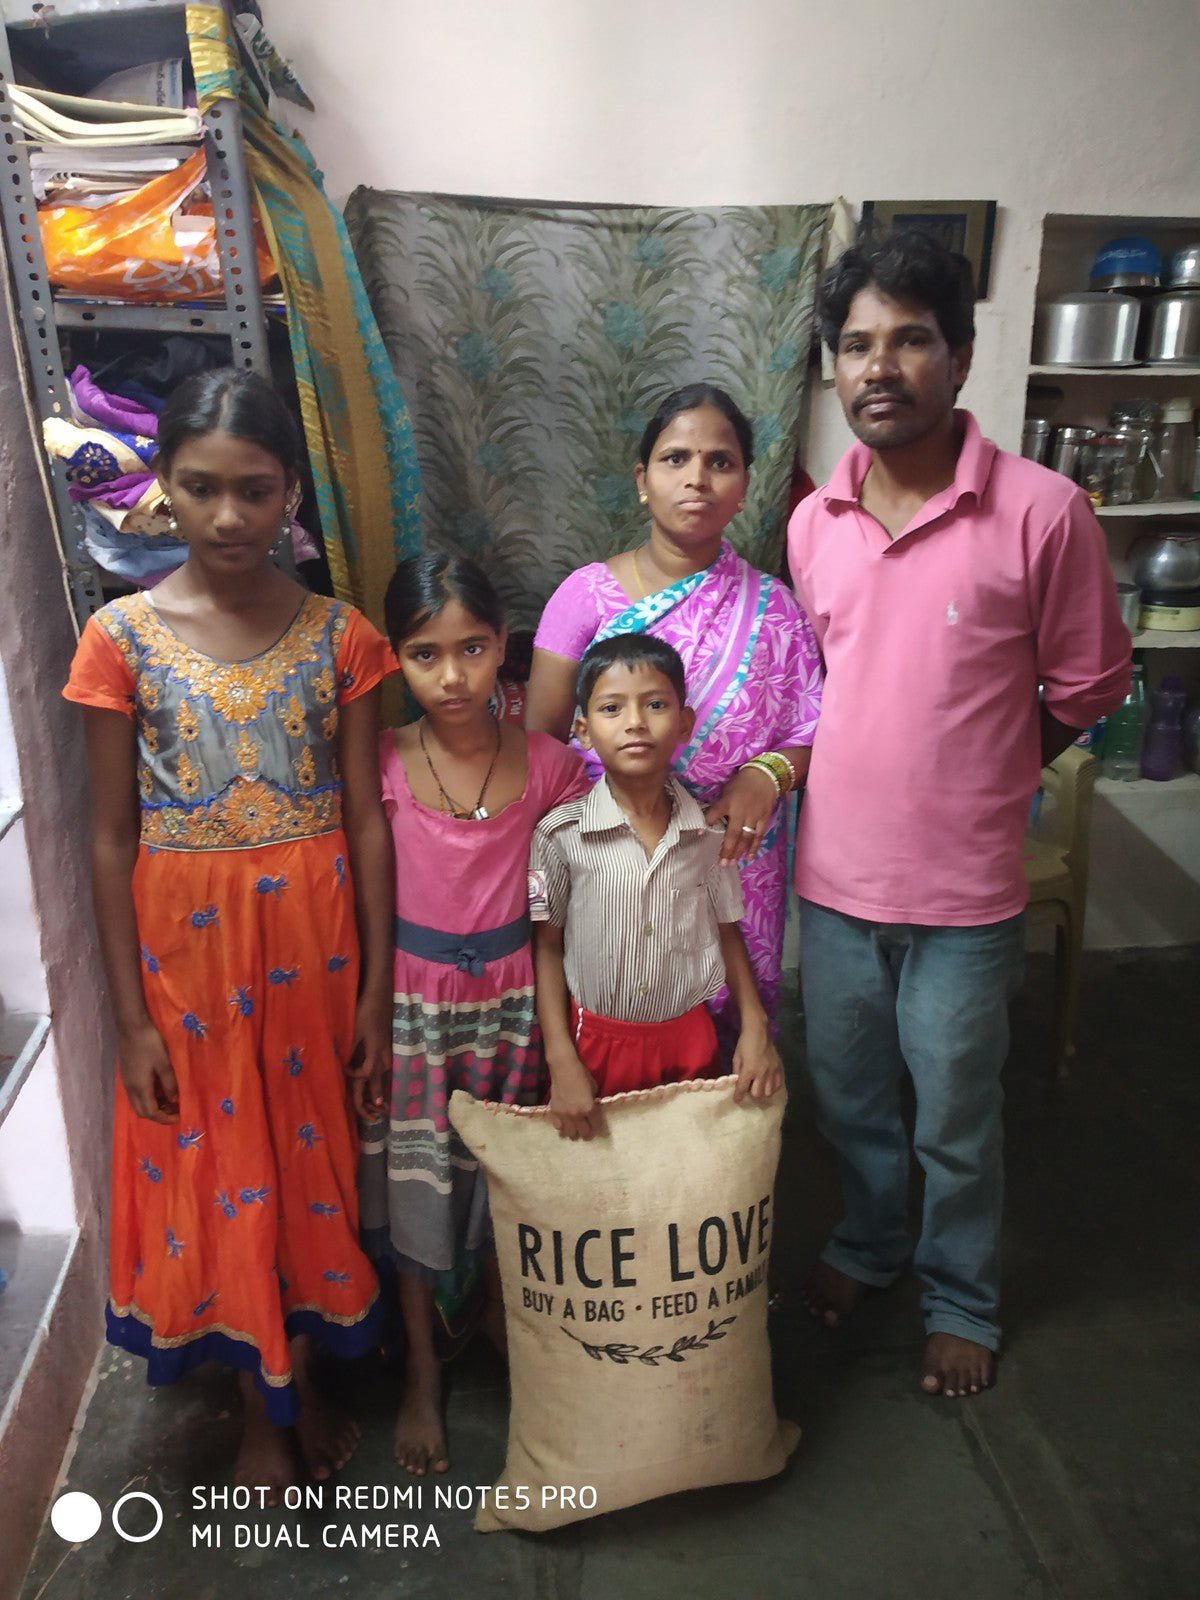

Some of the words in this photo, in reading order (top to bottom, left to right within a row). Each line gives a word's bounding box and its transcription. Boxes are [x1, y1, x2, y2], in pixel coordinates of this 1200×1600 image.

[518, 1223, 637, 1288] RICE
[668, 1195, 770, 1282] LOVE
[522, 1287, 556, 1316] BUY
[563, 1298, 576, 1322] A
[584, 1300, 625, 1322] BAG
[652, 1292, 698, 1320] FEED
[707, 1286, 720, 1310] A
